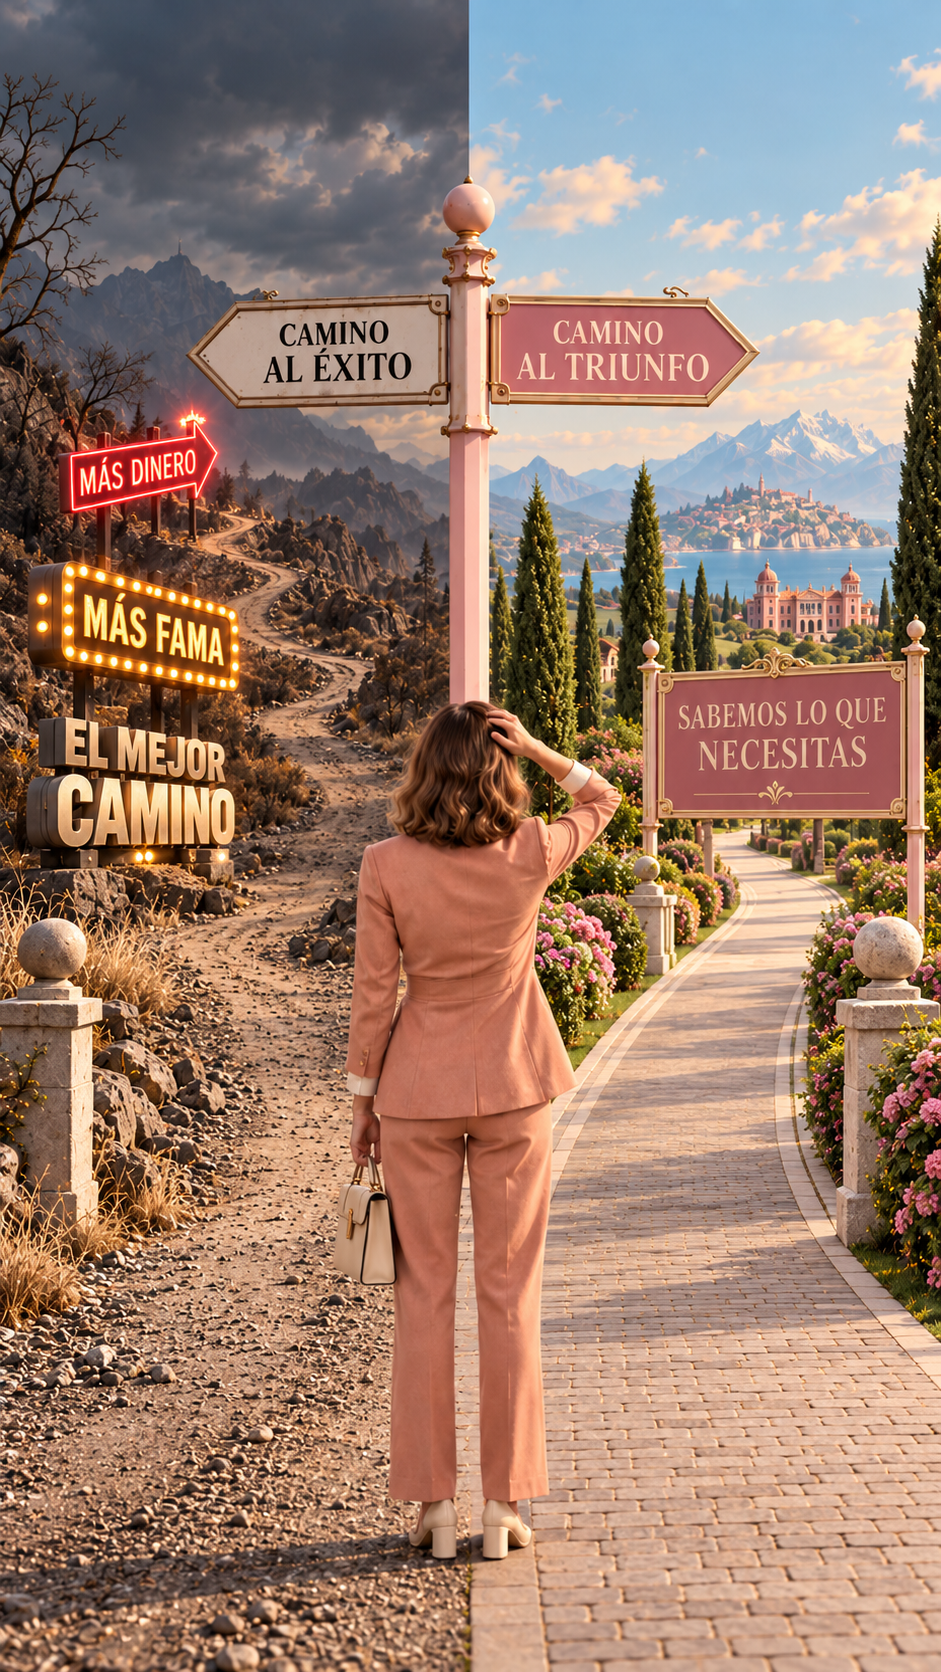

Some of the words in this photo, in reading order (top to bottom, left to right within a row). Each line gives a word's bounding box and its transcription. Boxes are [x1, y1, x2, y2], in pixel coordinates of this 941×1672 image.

[279, 320, 389, 347] CAMINO
[553, 320, 664, 345] CAMINO
[263, 355, 303, 383] AL
[313, 348, 412, 382] ÉXITO
[517, 352, 556, 380] AL
[564, 353, 709, 382] TRIUNFO
[79, 457, 123, 498] MÁS
[131, 449, 196, 485] DINERO
[83, 592, 147, 649] MÁS
[156, 613, 225, 666] FAMA
[678, 701, 787, 730] SABEMOS
[796, 699, 827, 726] LO
[835, 696, 887, 729] QUE
[65, 718, 108, 769] EL
[117, 726, 226, 783] MEJOR
[698, 735, 868, 771] NECESITAS
[57, 774, 235, 848] CAMINO
